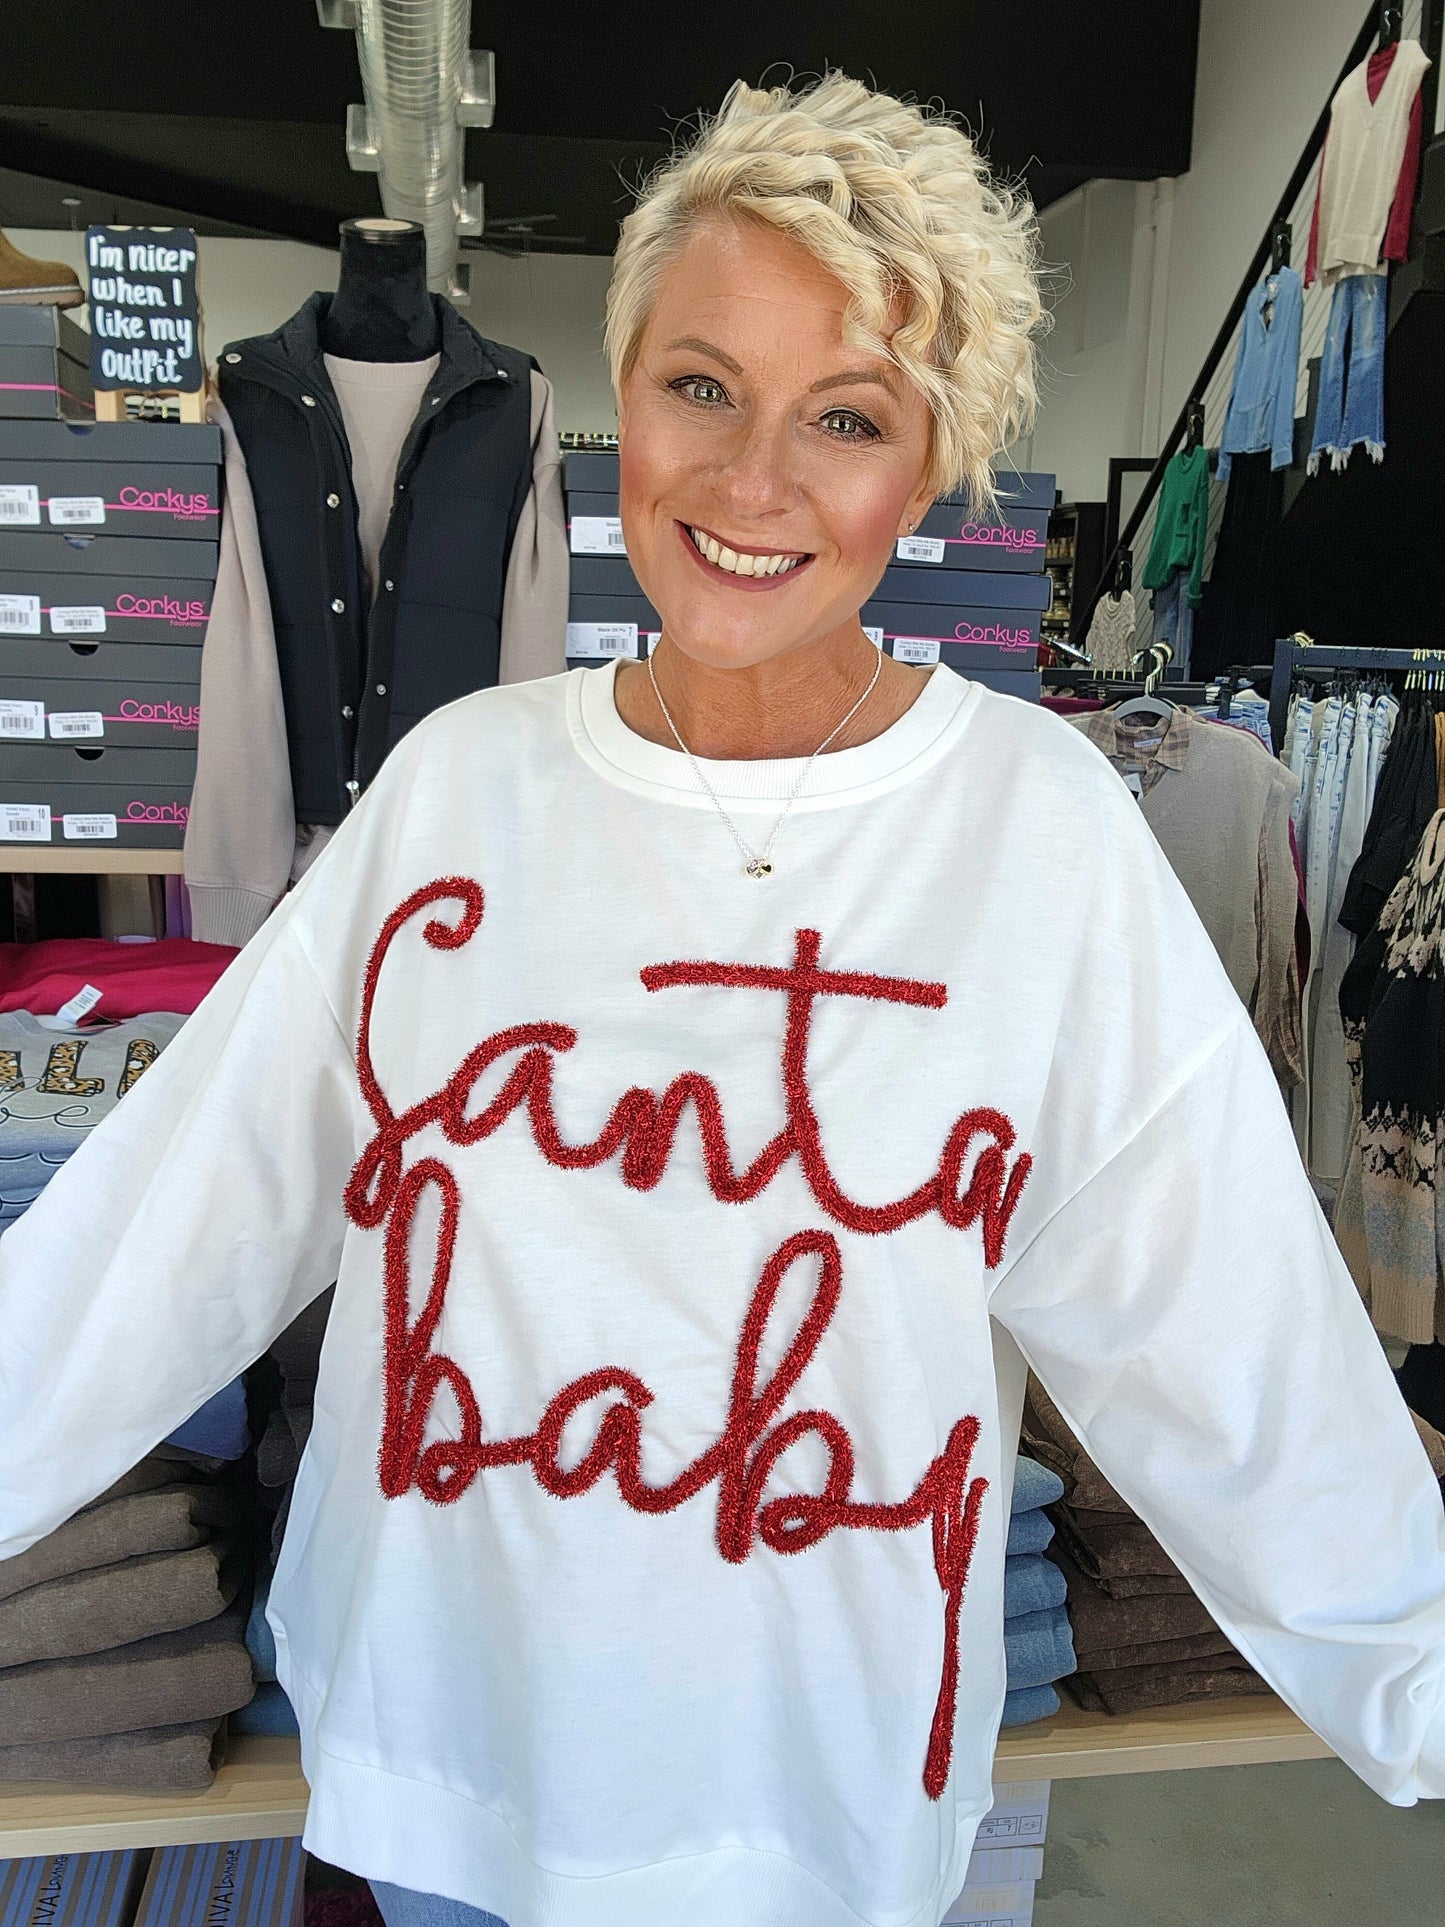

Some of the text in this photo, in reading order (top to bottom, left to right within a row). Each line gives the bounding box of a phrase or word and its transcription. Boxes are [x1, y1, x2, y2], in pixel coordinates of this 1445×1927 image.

[89, 234, 196, 273] I'm nicer
[92, 276, 183, 307] when I
[95, 305, 193, 360] like my
[119, 486, 210, 515] Corkys
[962, 522, 1040, 548] Corkys
[116, 593, 206, 621] Corkys
[954, 622, 1032, 648] Corkys
[377, 1157, 988, 1799] baby
